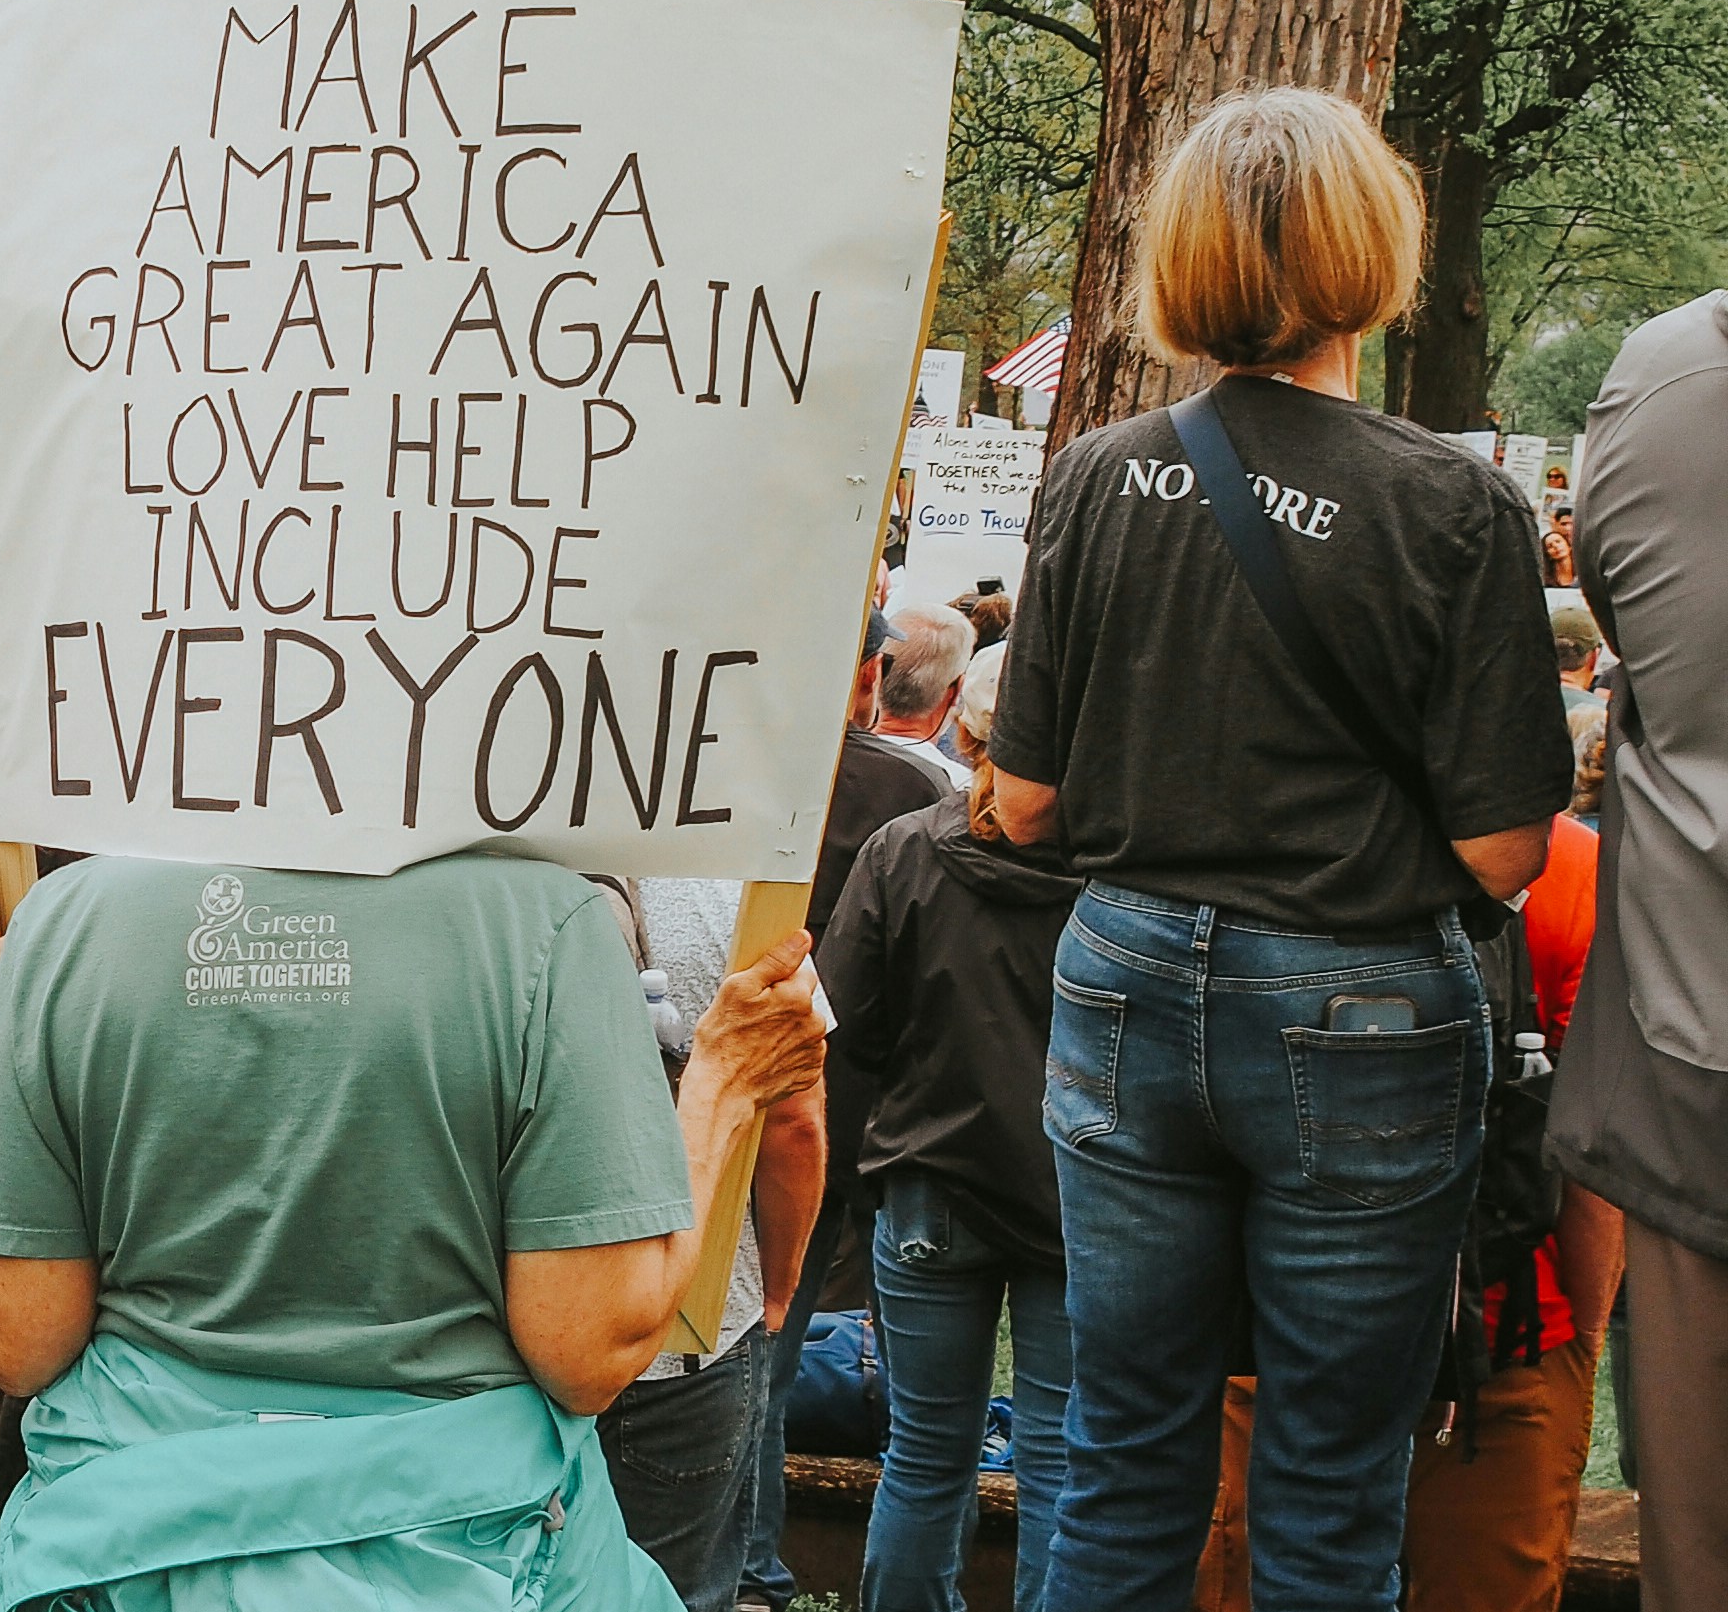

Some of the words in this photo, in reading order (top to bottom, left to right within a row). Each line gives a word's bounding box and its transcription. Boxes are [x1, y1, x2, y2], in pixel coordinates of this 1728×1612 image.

[136, 145, 664, 267] AMERICA
[61, 260, 404, 375] GREAT
[430, 267, 820, 407] AGAIN
[123, 387, 349, 495] LOVE
[387, 393, 636, 508] HELP
[934, 432, 969, 449] Alone
[975, 438, 992, 449] we
[997, 439, 1019, 449] are
[926, 462, 1001, 479] TOGETHER
[1008, 471, 1024, 480] we
[1028, 471, 1044, 481] ar
[954, 450, 1019, 466] raindrops
[943, 482, 965, 494] the
[981, 483, 1030, 495] STORM
[1118, 458, 1195, 501] NO
[1199, 473, 1341, 541] ORE
[919, 505, 970, 527] GOOD
[980, 509, 1026, 530] TROU
[143, 504, 604, 639] INCLUDE
[44, 622, 758, 830] EVERYONE
[242, 905, 337, 935] Green
[220, 932, 350, 962] America
[185, 964, 245, 991] COME
[248, 962, 352, 988] TOGETHER
[186, 989, 351, 1007] GreenAmerica.org
